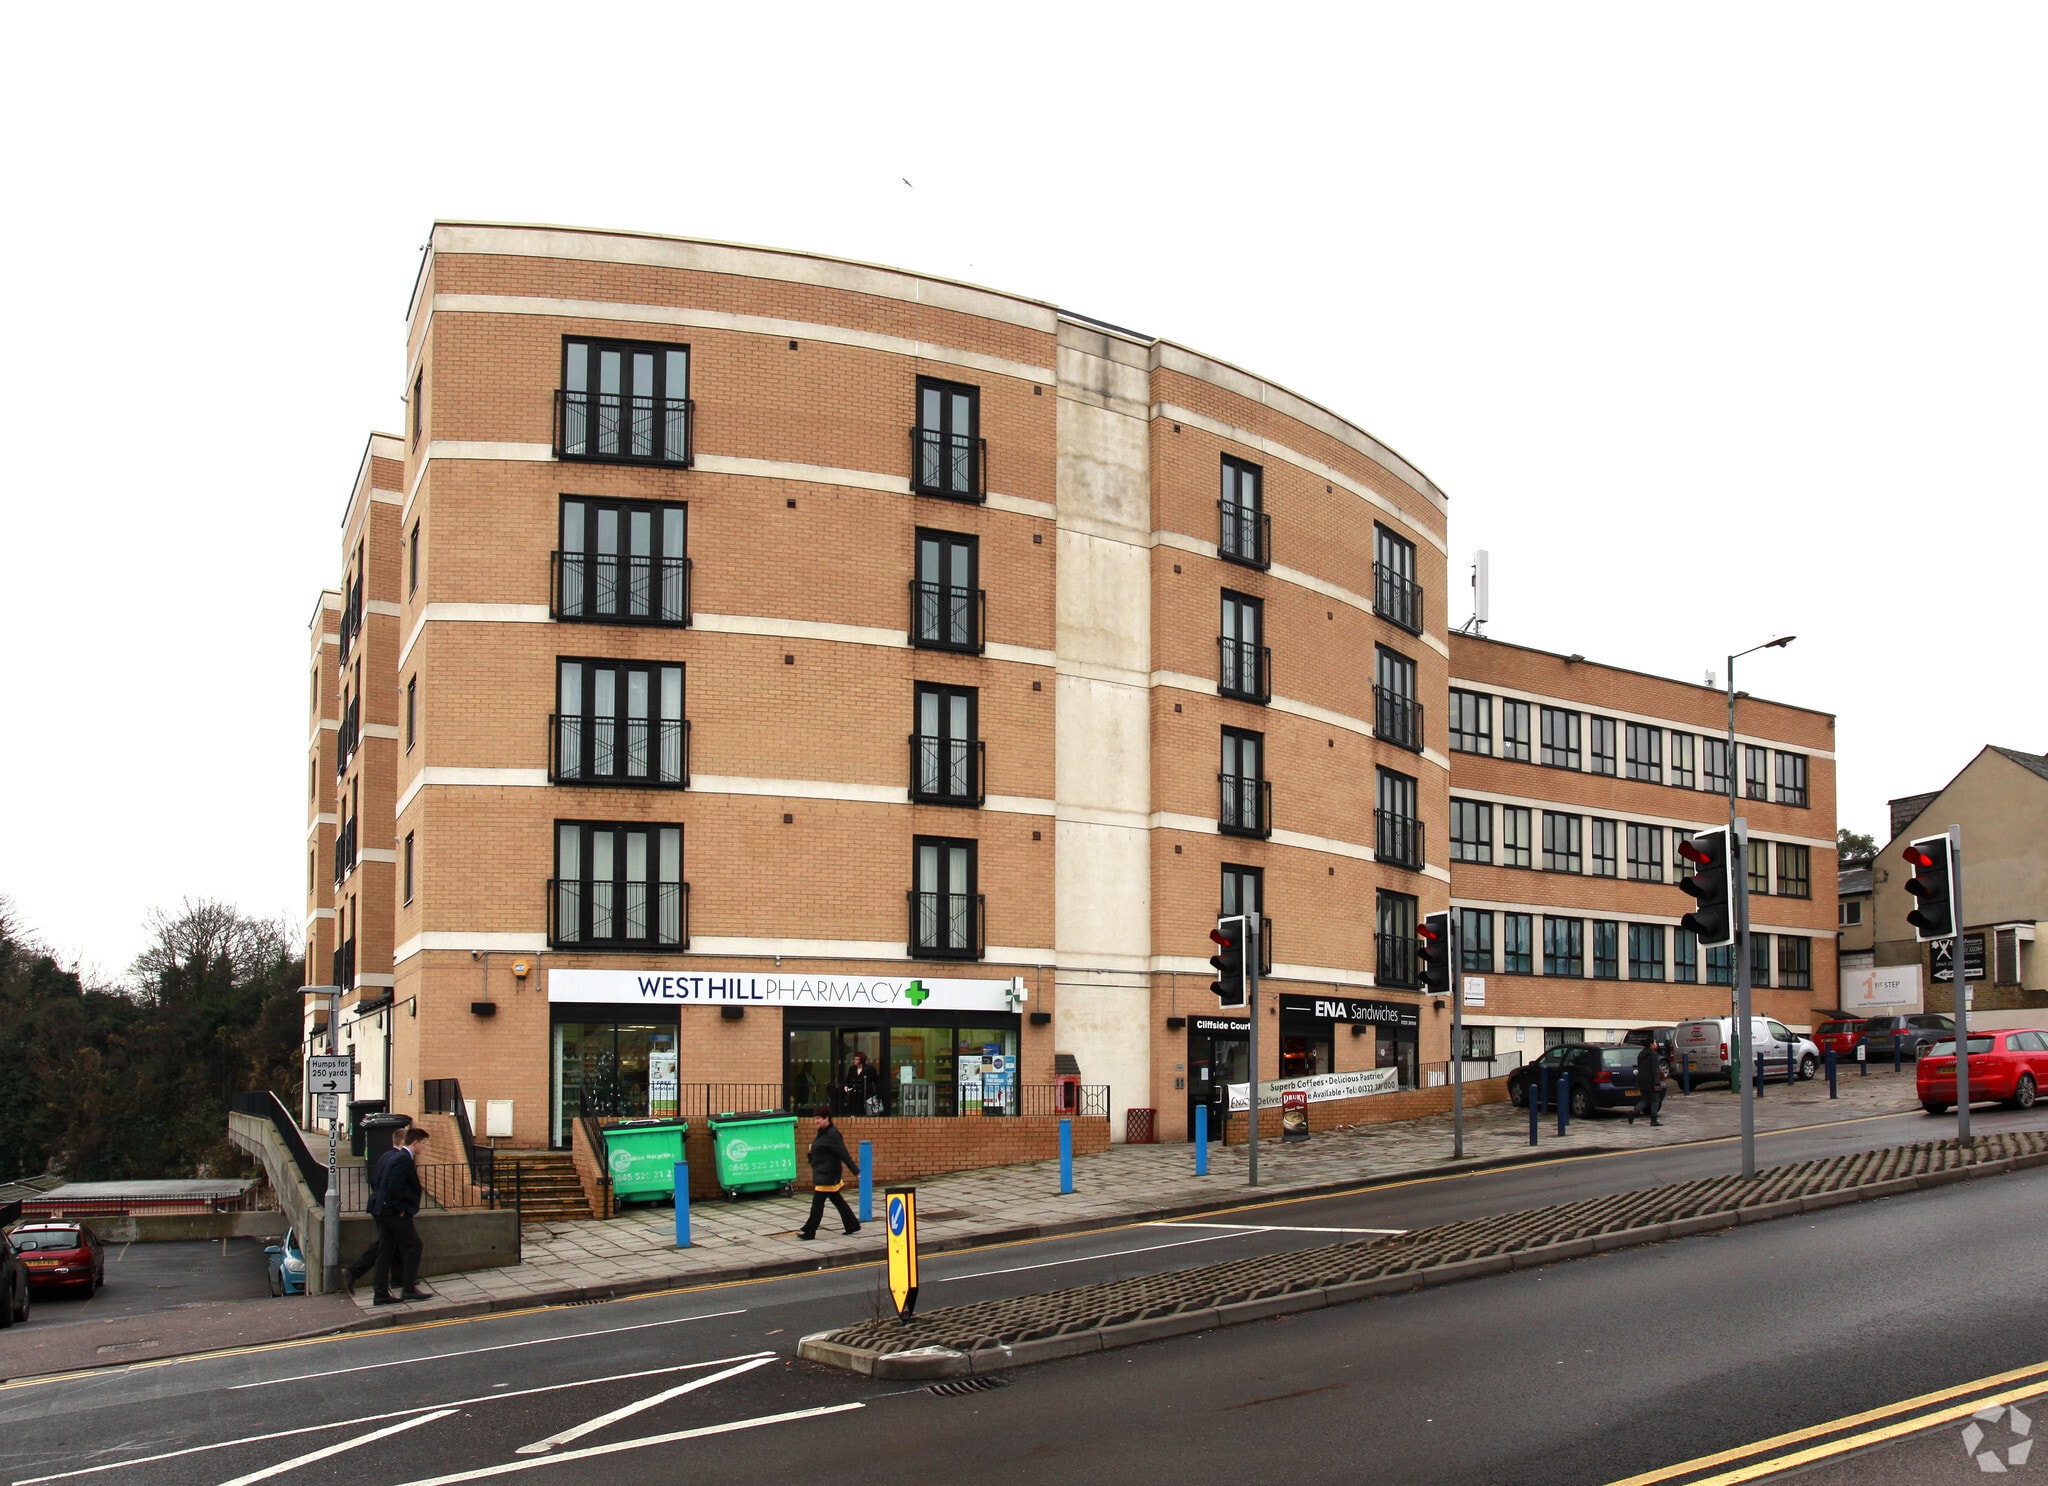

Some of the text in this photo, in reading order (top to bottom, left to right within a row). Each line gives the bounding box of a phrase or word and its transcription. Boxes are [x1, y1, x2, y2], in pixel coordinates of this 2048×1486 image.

[1884, 980, 1900, 988] STEP
[637, 976, 903, 1004] WEST HILL PHARMACY
[1315, 1000, 1399, 1022] ENA Sandwiches
[1196, 1019, 1229, 1030] Cliffside
[312, 1060, 348, 1068] Humps for
[312, 1069, 348, 1078] 250 yards
[1270, 1072, 1384, 1092] Superb Coffees Delicious Pastries
[1256, 1095, 1282, 1105] Deliver
[1312, 1089, 1342, 1100] Available
[762, 1142, 792, 1152] Recycling
[646, 1152, 676, 1162] Recycling
[728, 1159, 792, 1172] 0845 520 21 21
[653, 1170, 664, 1179] 21
[665, 1169, 674, 1178] 2
